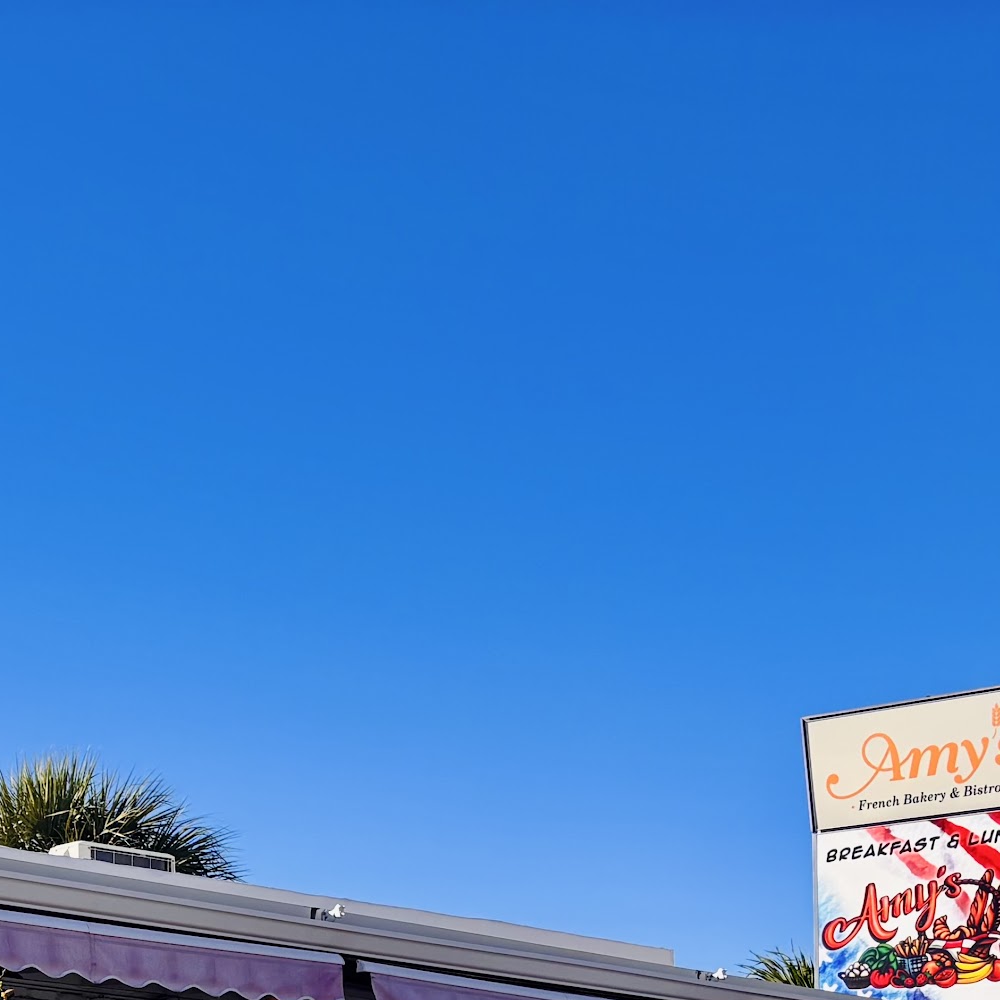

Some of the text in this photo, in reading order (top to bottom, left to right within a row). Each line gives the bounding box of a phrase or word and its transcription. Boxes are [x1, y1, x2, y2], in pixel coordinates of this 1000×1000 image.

[858, 783, 1000, 812] French Bakery & Bistro
[826, 835, 941, 863] BREAKFAST
[946, 833, 960, 849] &
[821, 864, 962, 952] Amy's
